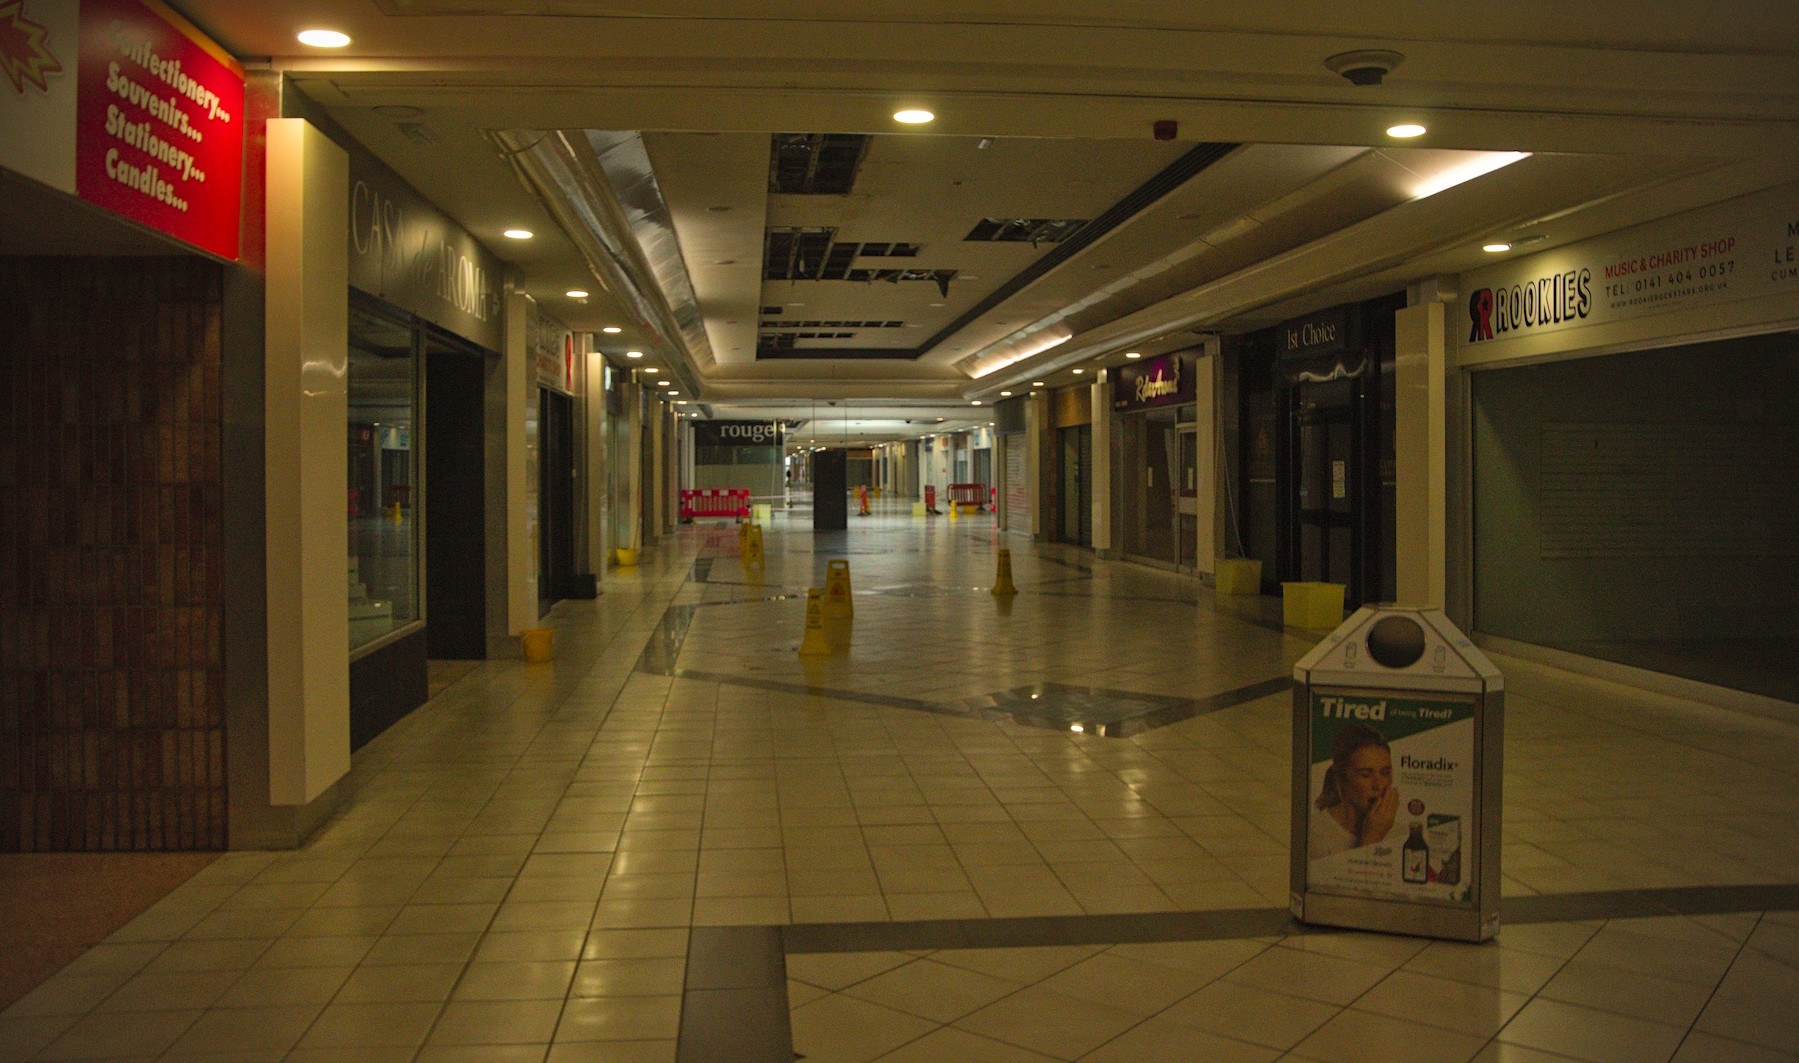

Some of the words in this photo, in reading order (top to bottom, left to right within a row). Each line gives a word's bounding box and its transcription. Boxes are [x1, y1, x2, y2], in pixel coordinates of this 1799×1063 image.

[106, 61, 203, 143] Souvenirs...
[105, 104, 205, 182] Stationery...
[105, 147, 189, 213] Candles...
[1605, 261, 1637, 279] MUSIC
[1640, 257, 1647, 272] &
[1649, 245, 1698, 270] CHARITY
[1701, 236, 1736, 259] SHOP
[1605, 284, 1630, 298] TEL:
[1635, 275, 1661, 292] 0141
[1668, 269, 1692, 284] 404
[1699, 260, 1736, 279] 0057
[436, 239, 487, 322] AROMA
[1496, 268, 1592, 334] ROOKIES
[1288, 329, 1299, 351] 1st
[1302, 321, 1336, 346] Choice
[720, 424, 774, 443] rouge
[1320, 696, 1387, 721] Tired
[1418, 707, 1453, 719] Tired?
[1400, 755, 1454, 771] Floradix
